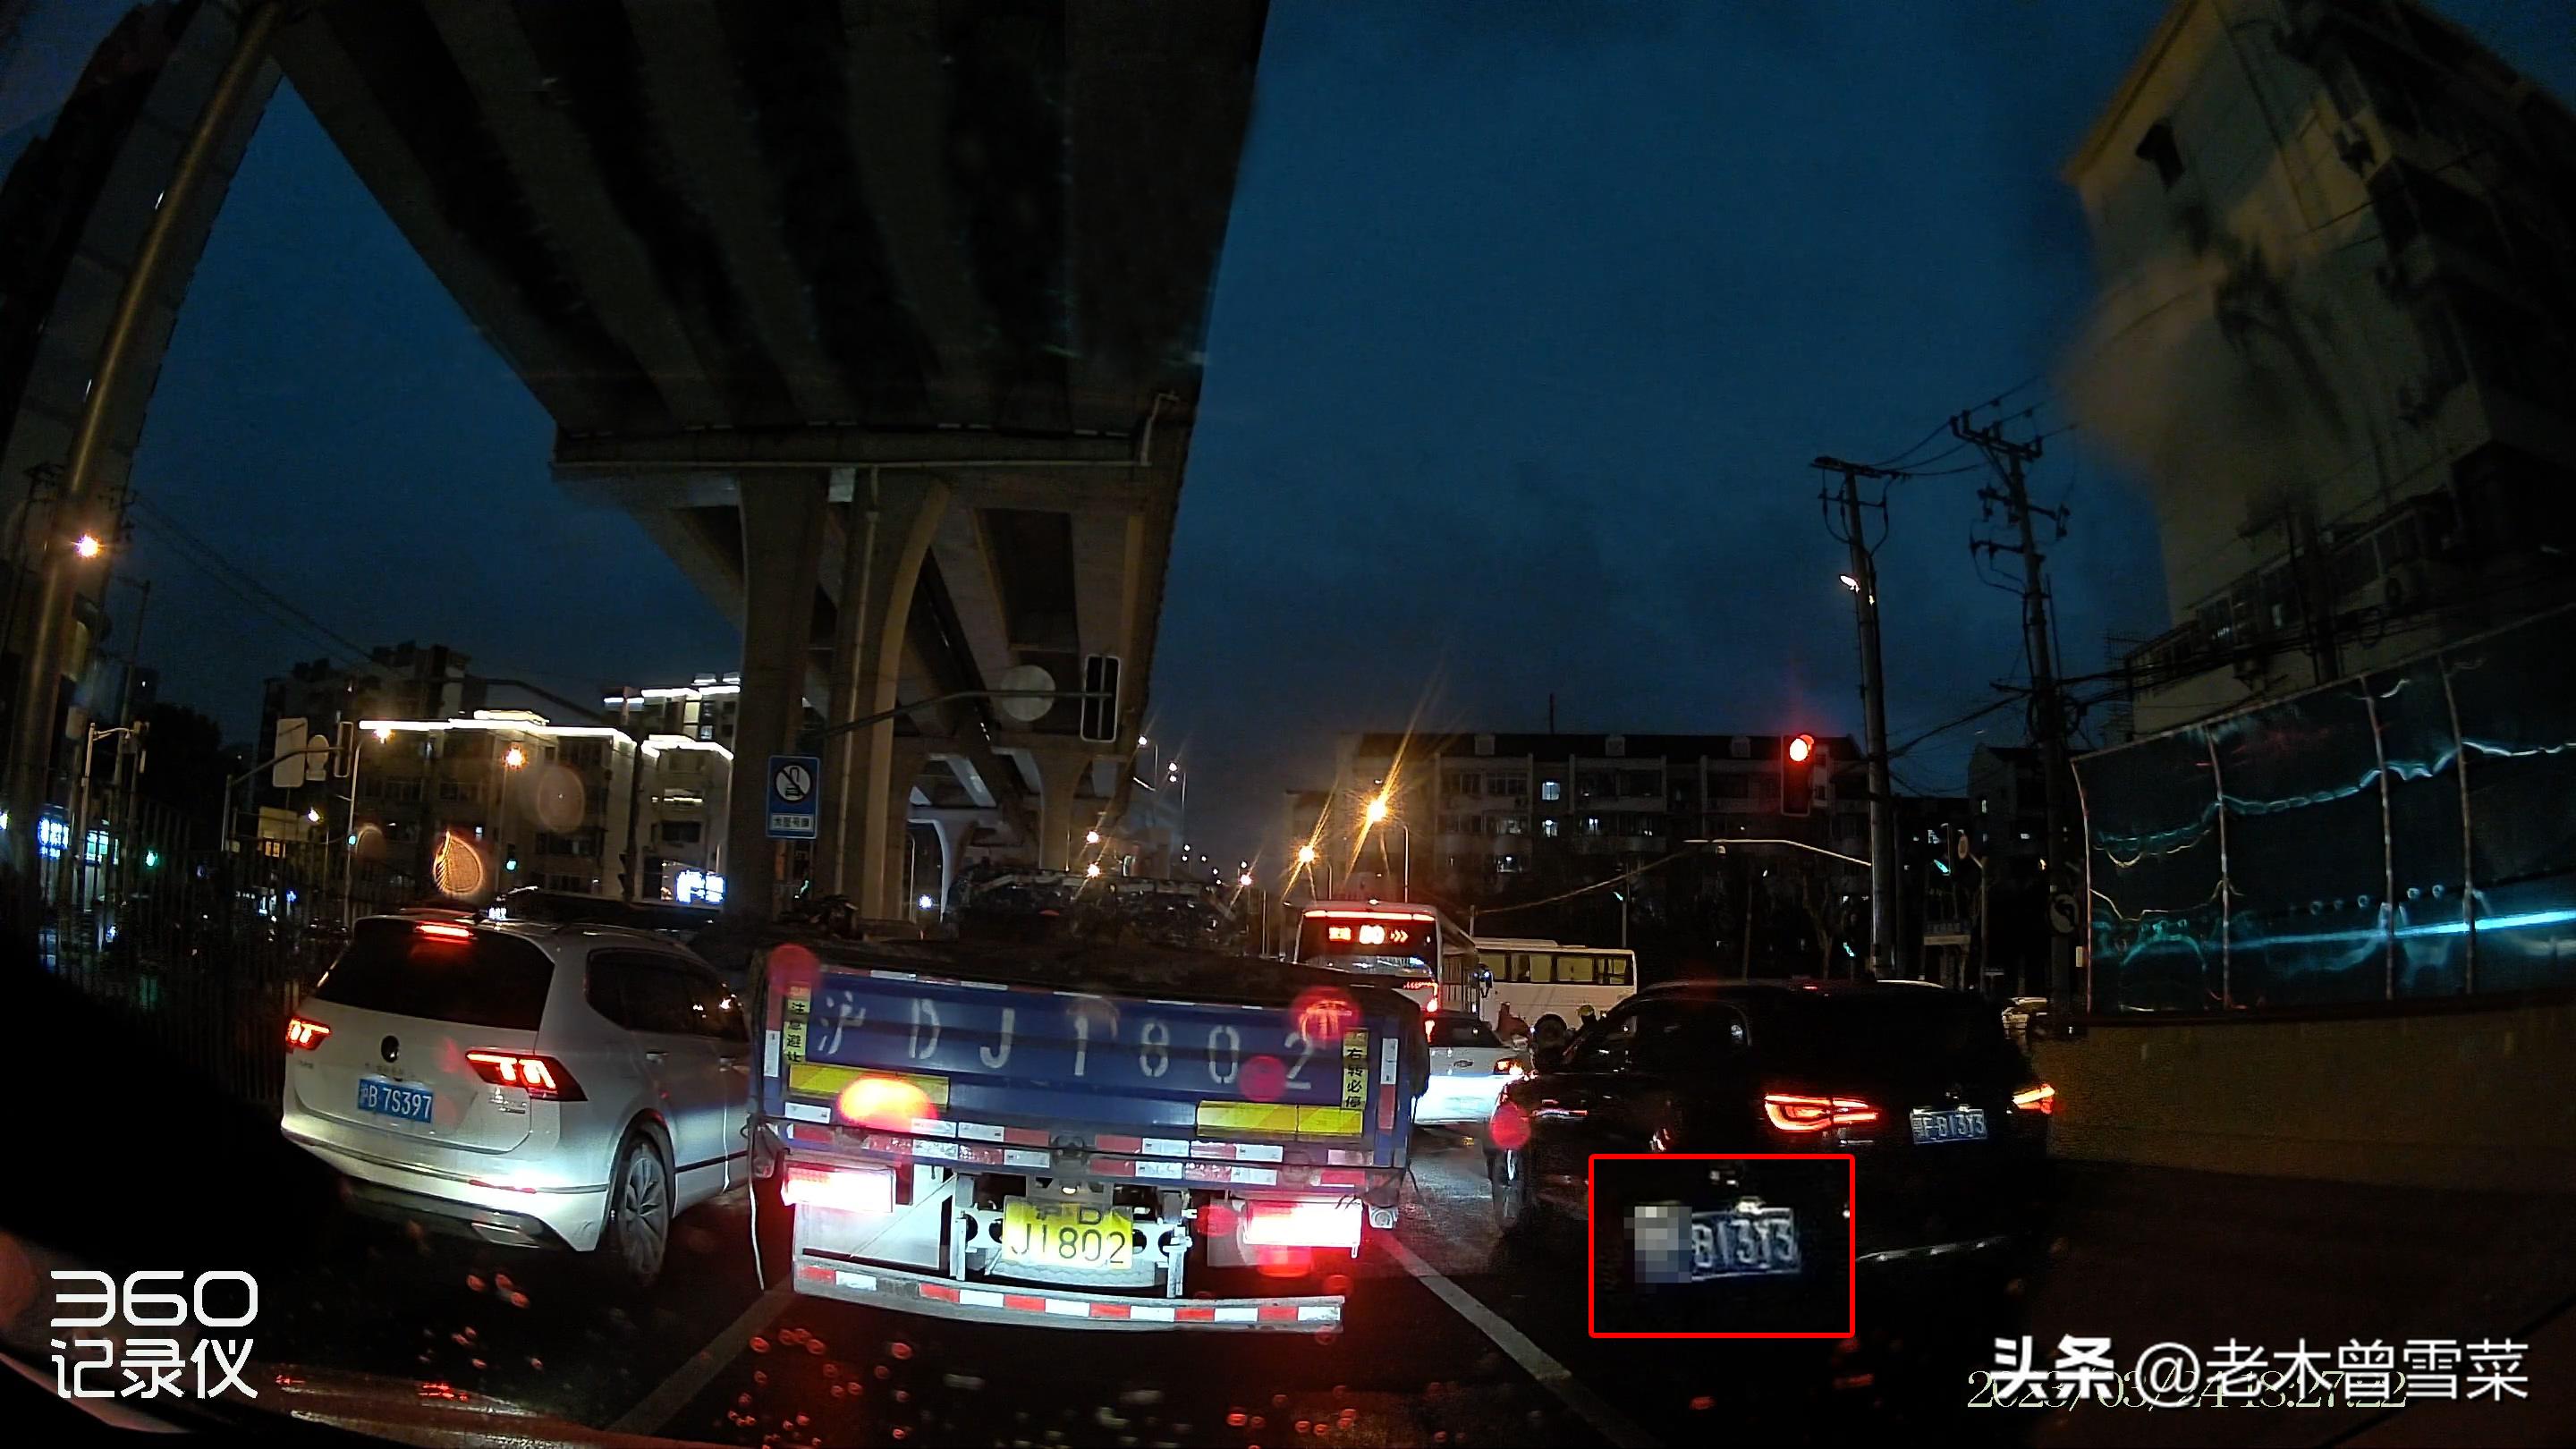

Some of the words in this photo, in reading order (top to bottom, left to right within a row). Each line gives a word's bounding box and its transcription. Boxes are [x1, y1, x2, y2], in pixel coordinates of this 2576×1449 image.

[1344, 1046, 1363, 1109] 右转必停
[1011, 1223, 1126, 1264] J1802
